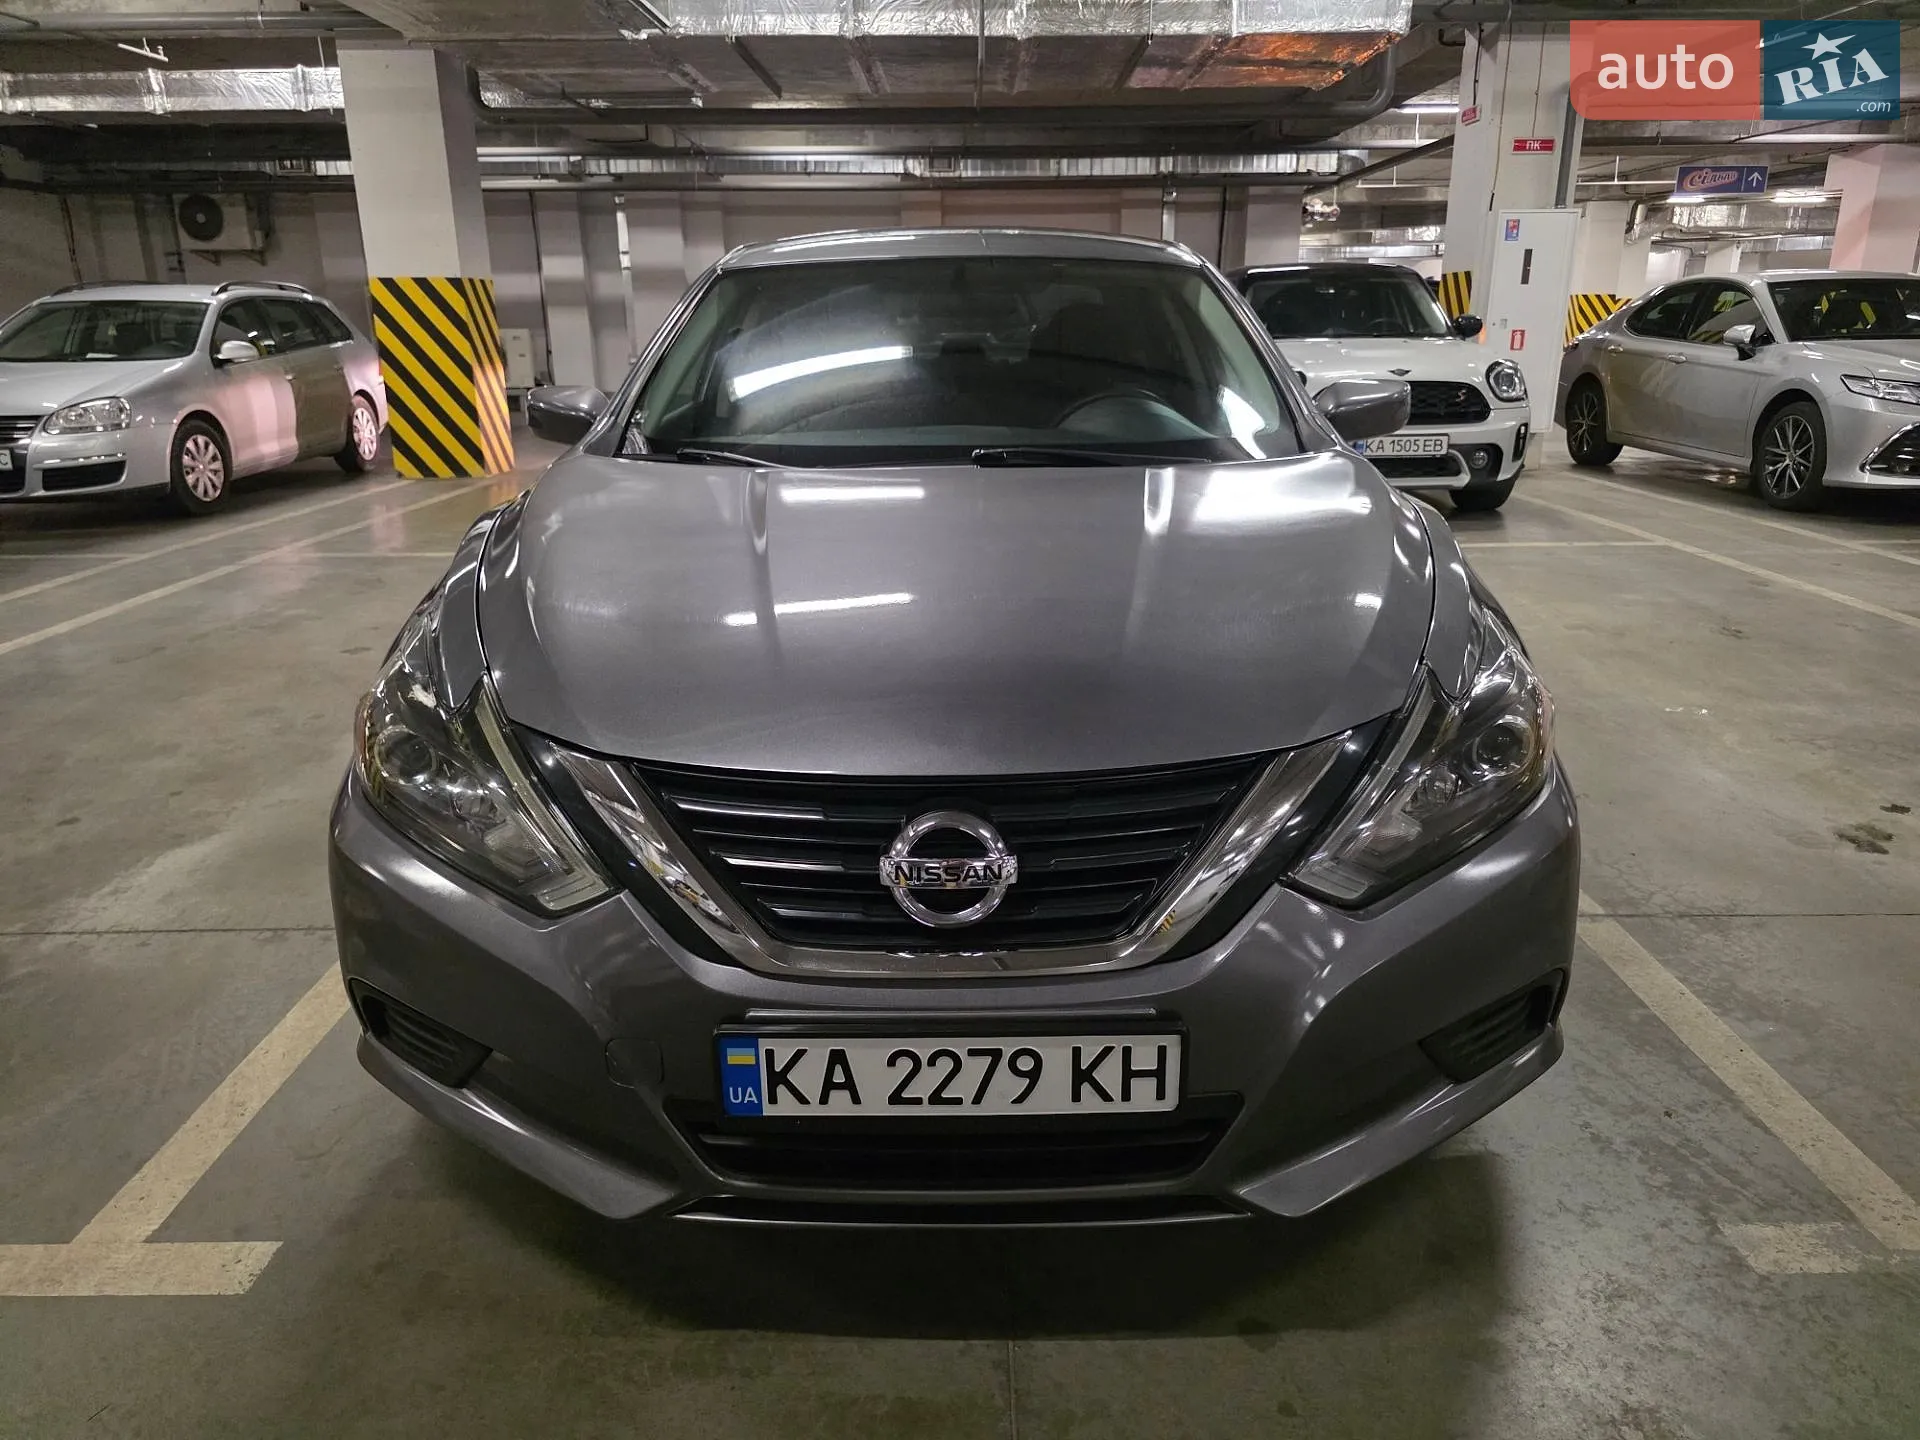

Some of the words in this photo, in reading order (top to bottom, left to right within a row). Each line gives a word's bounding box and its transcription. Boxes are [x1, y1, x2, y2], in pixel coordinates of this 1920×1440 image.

[1526, 140, 1541, 150] ПК
[1365, 439, 1384, 453] KA
[1389, 439, 1420, 453] 1505
[1423, 439, 1443, 453] EB
[894, 865, 1003, 883] NISSAN
[764, 1047, 862, 1106] KA
[886, 1047, 1044, 1105] 2279
[1070, 1044, 1168, 1103] KH
[729, 1086, 759, 1105] UA
